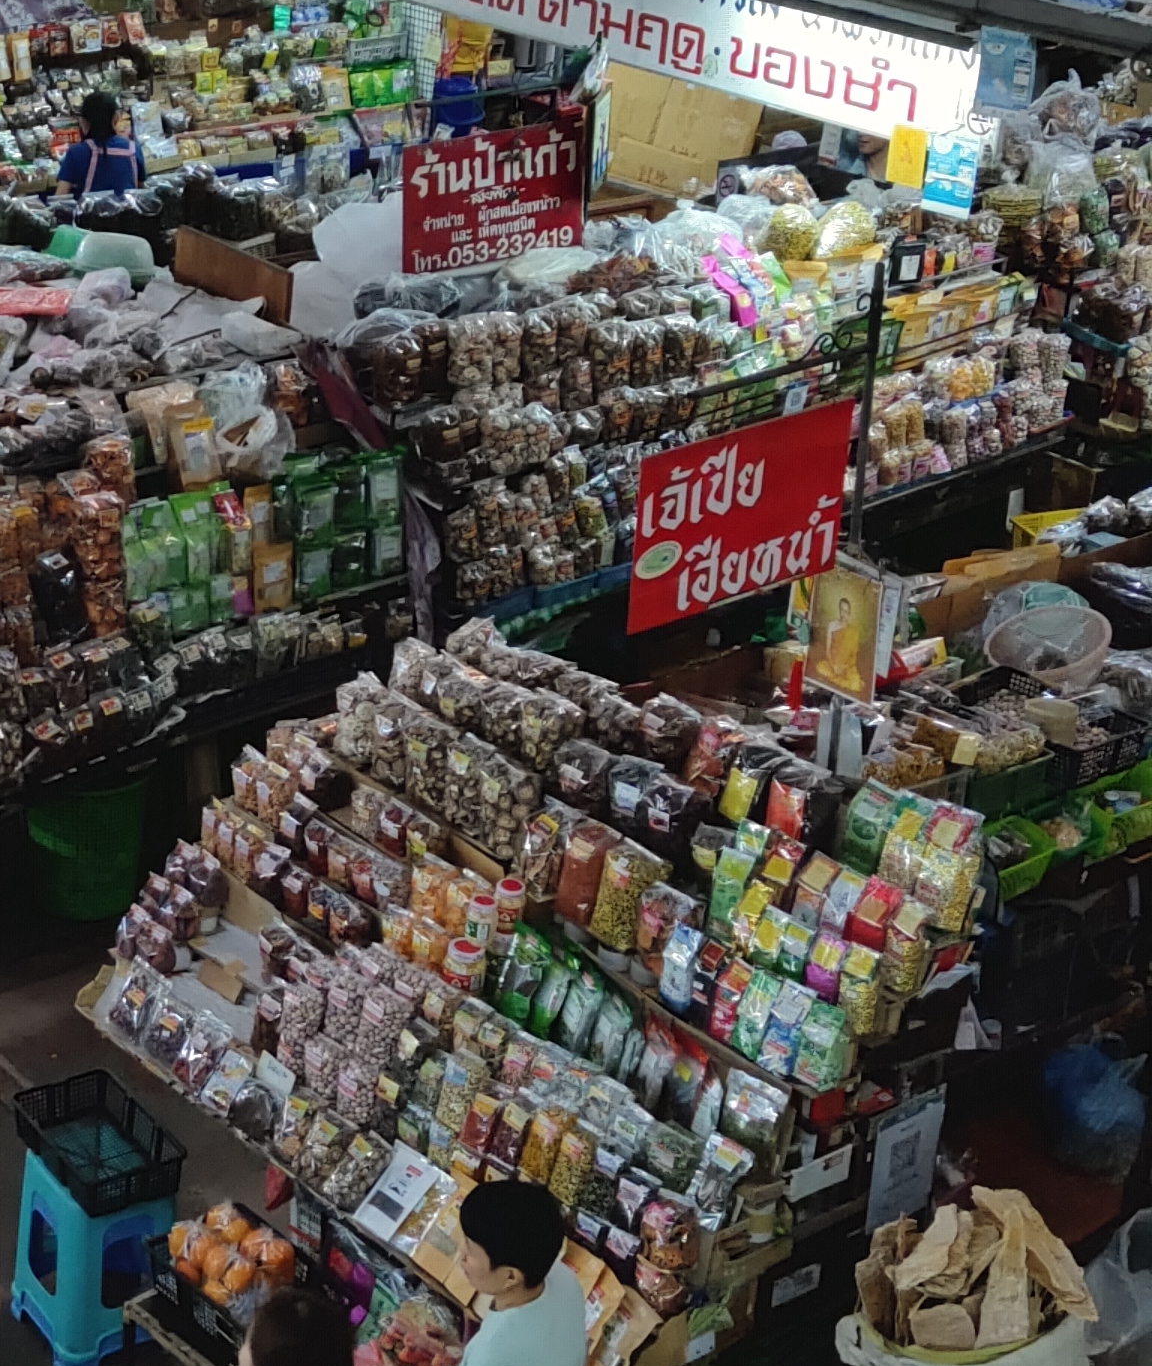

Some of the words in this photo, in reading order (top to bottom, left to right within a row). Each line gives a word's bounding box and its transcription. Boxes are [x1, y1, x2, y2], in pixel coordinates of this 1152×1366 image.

[729, 35, 918, 123] ของชำ
[410, 127, 577, 199] ร้านป้าแก้ว
[423, 213, 465, 232] จำหน่าย
[451, 228, 472, 243] และ
[478, 215, 536, 241] เห็ดทุกชนิด
